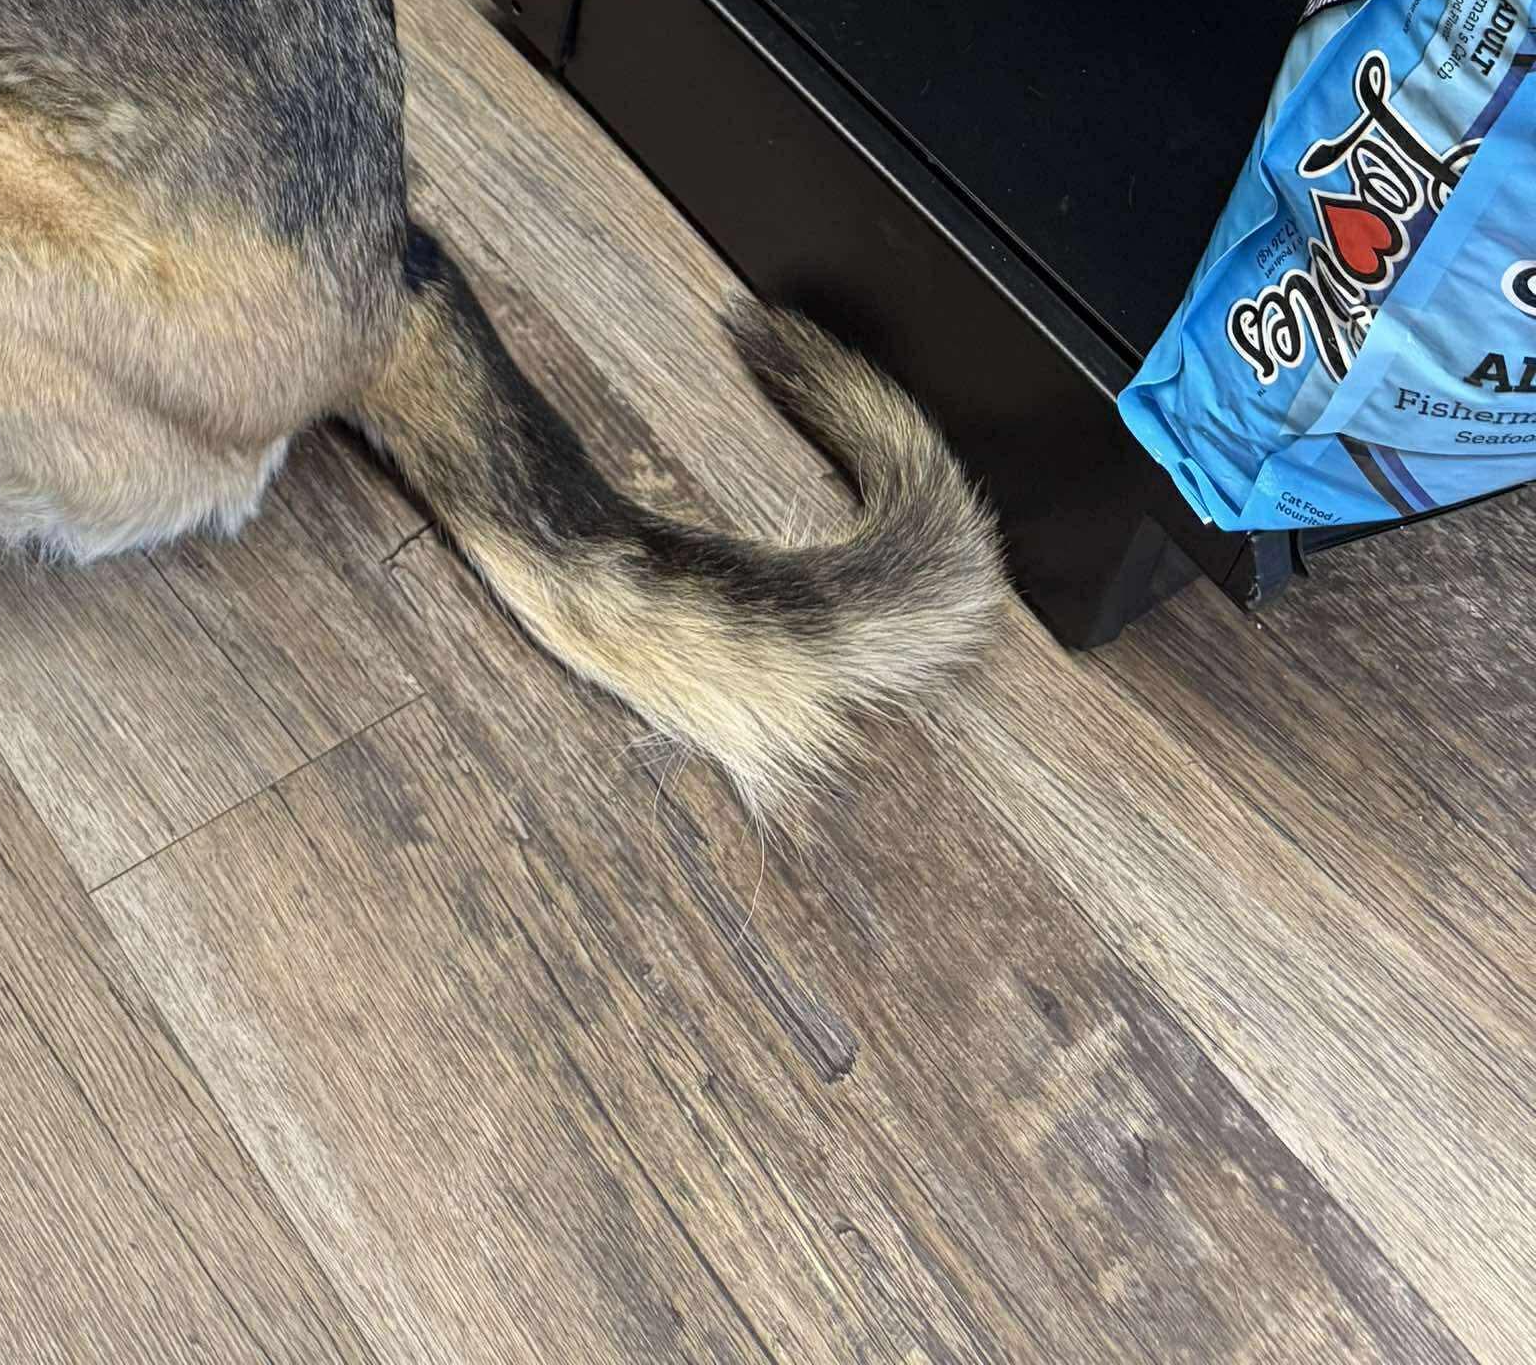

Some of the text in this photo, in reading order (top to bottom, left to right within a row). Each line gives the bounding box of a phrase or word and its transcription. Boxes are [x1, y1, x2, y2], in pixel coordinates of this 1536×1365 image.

[1437, 39, 1467, 81] Catch
[1279, 490, 1301, 509] Cat
[1302, 499, 1334, 523] Food
